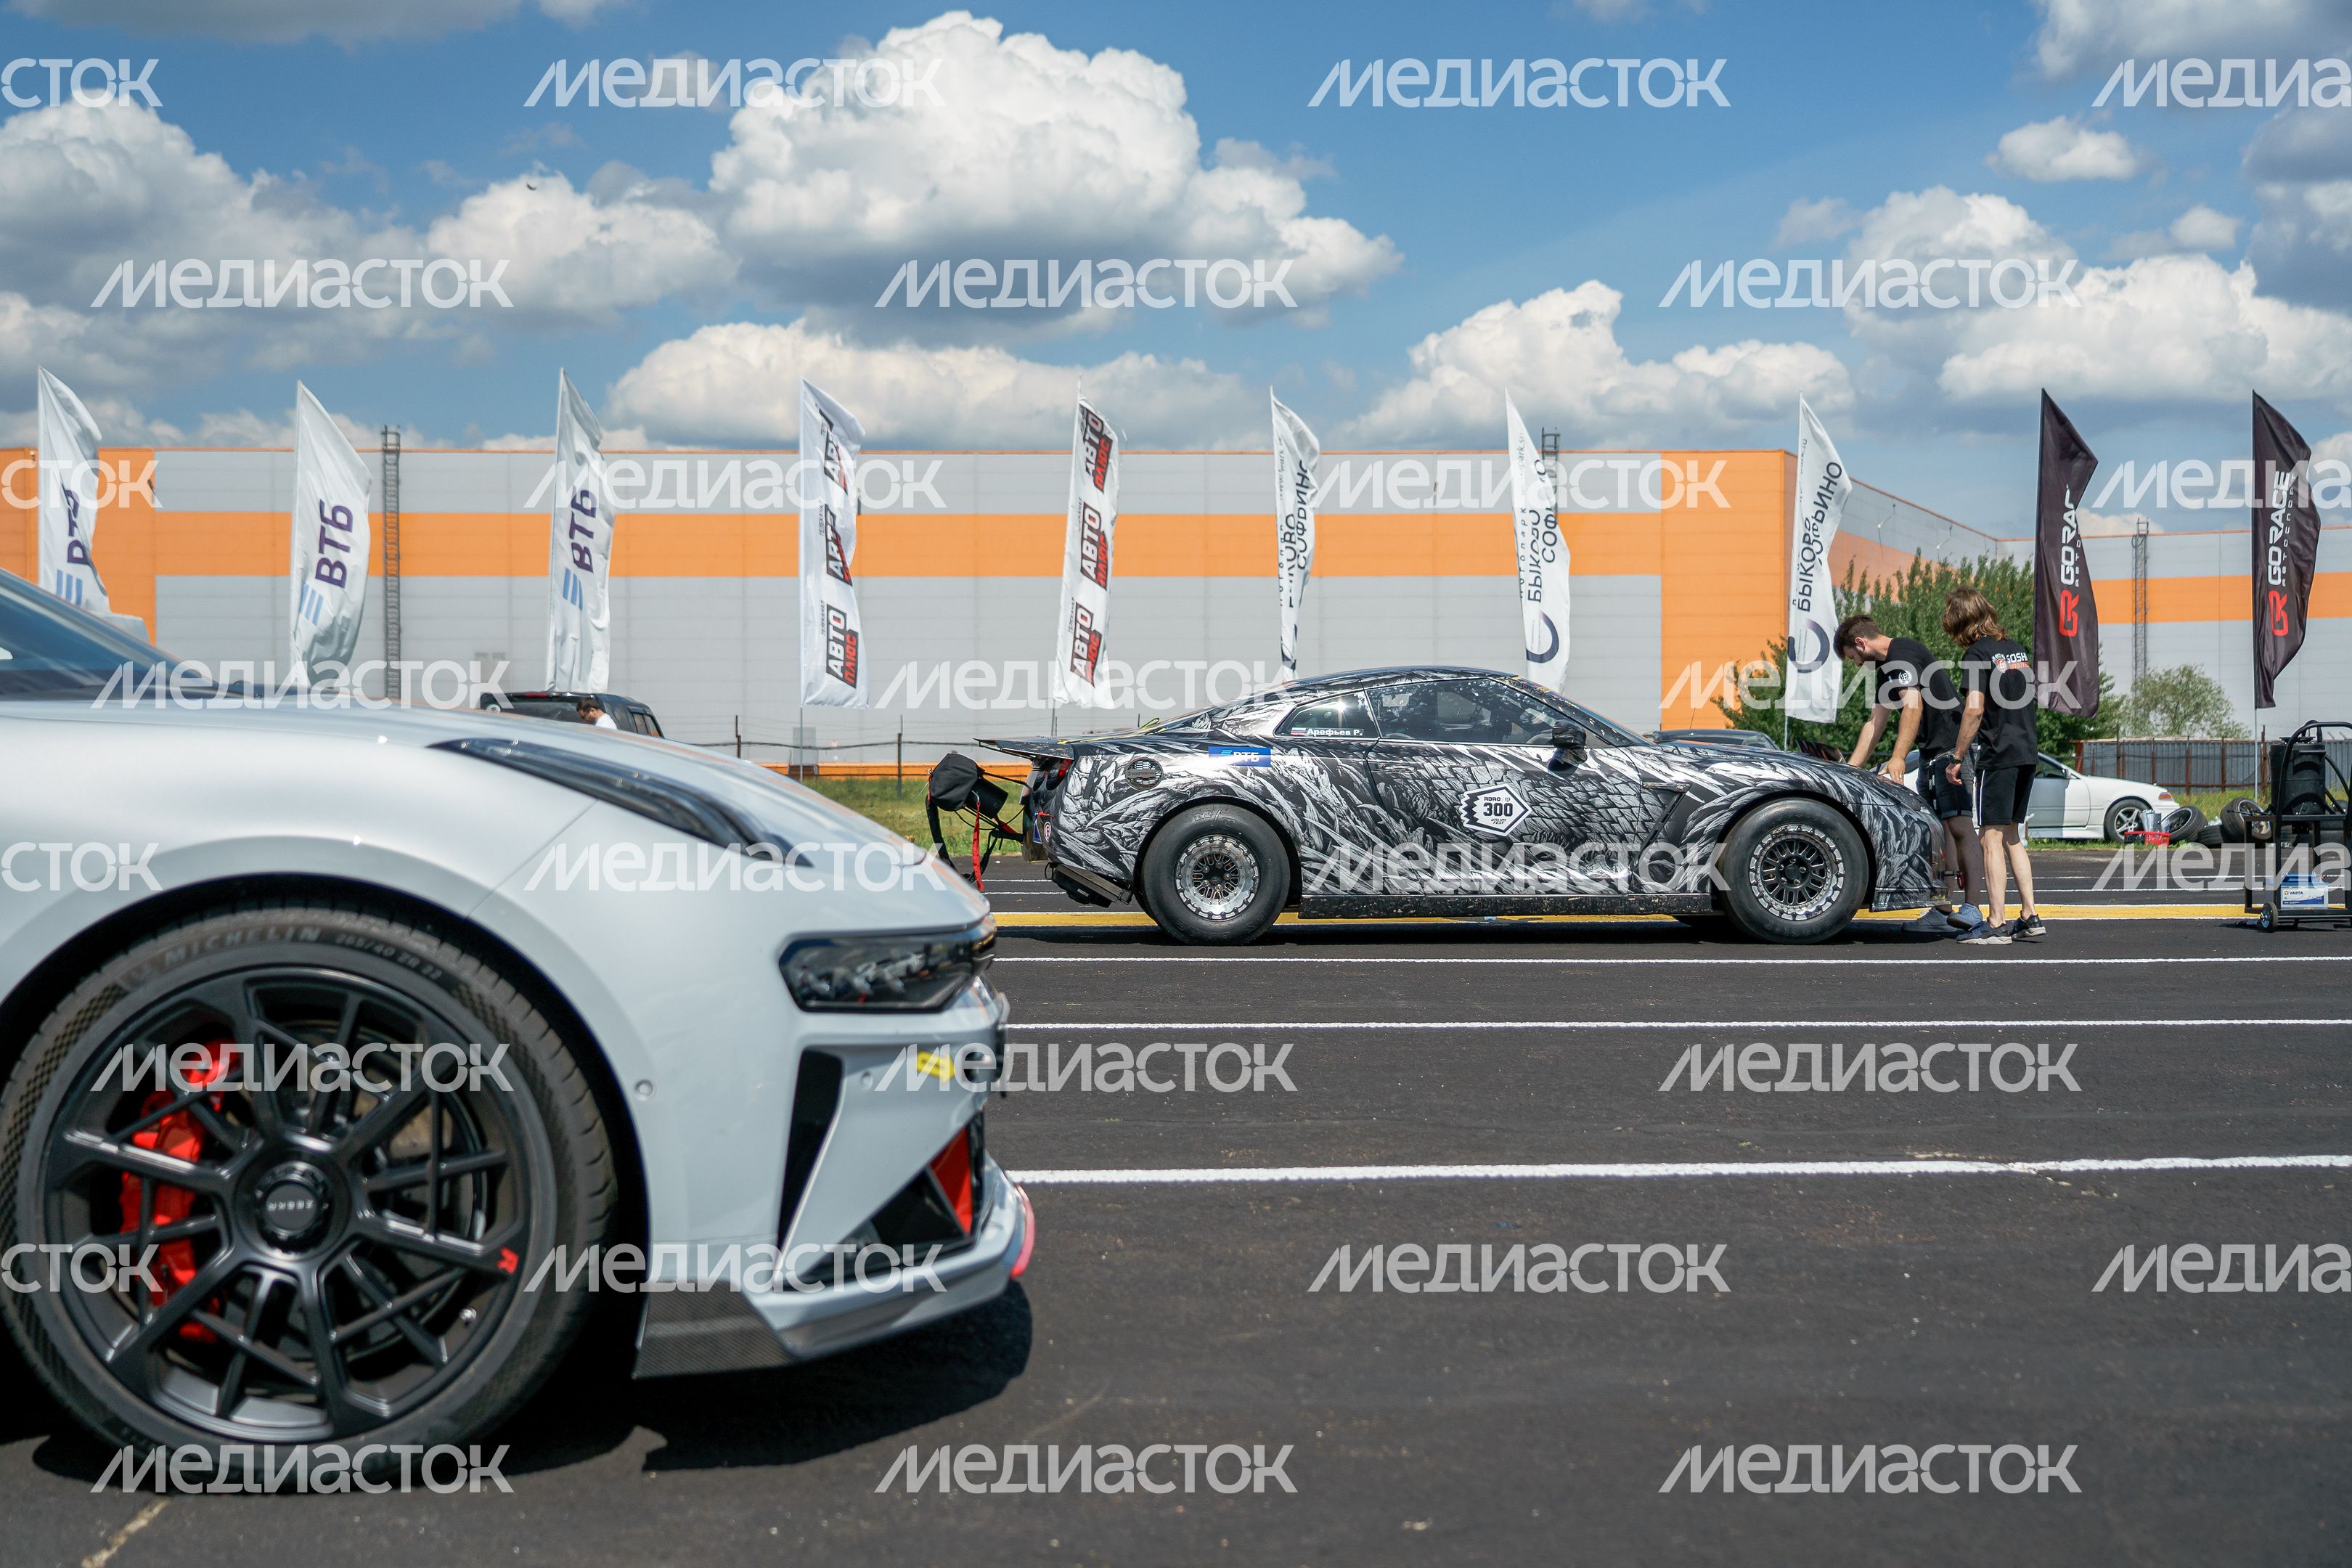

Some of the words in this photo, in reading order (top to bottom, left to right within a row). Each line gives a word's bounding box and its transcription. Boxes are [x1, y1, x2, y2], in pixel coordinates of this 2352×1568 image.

[1084, 412, 1103, 477] АВТО
[1094, 437, 1111, 489] ПЛЮС
[315, 499, 354, 589] ВТБ
[570, 485, 597, 573] ВТБ
[1082, 510, 1101, 580] АВТО
[2060, 484, 2077, 586] GORA
[2267, 470, 2290, 586] GORACE
[828, 608, 846, 679] АВТО
[844, 632, 857, 685] ПЛЮС
[1073, 606, 1093, 679] АВТО
[1307, 728, 1350, 737] Арефьев
[1483, 802, 1513, 817] 300
[164, 927, 322, 966] MICHELIN
